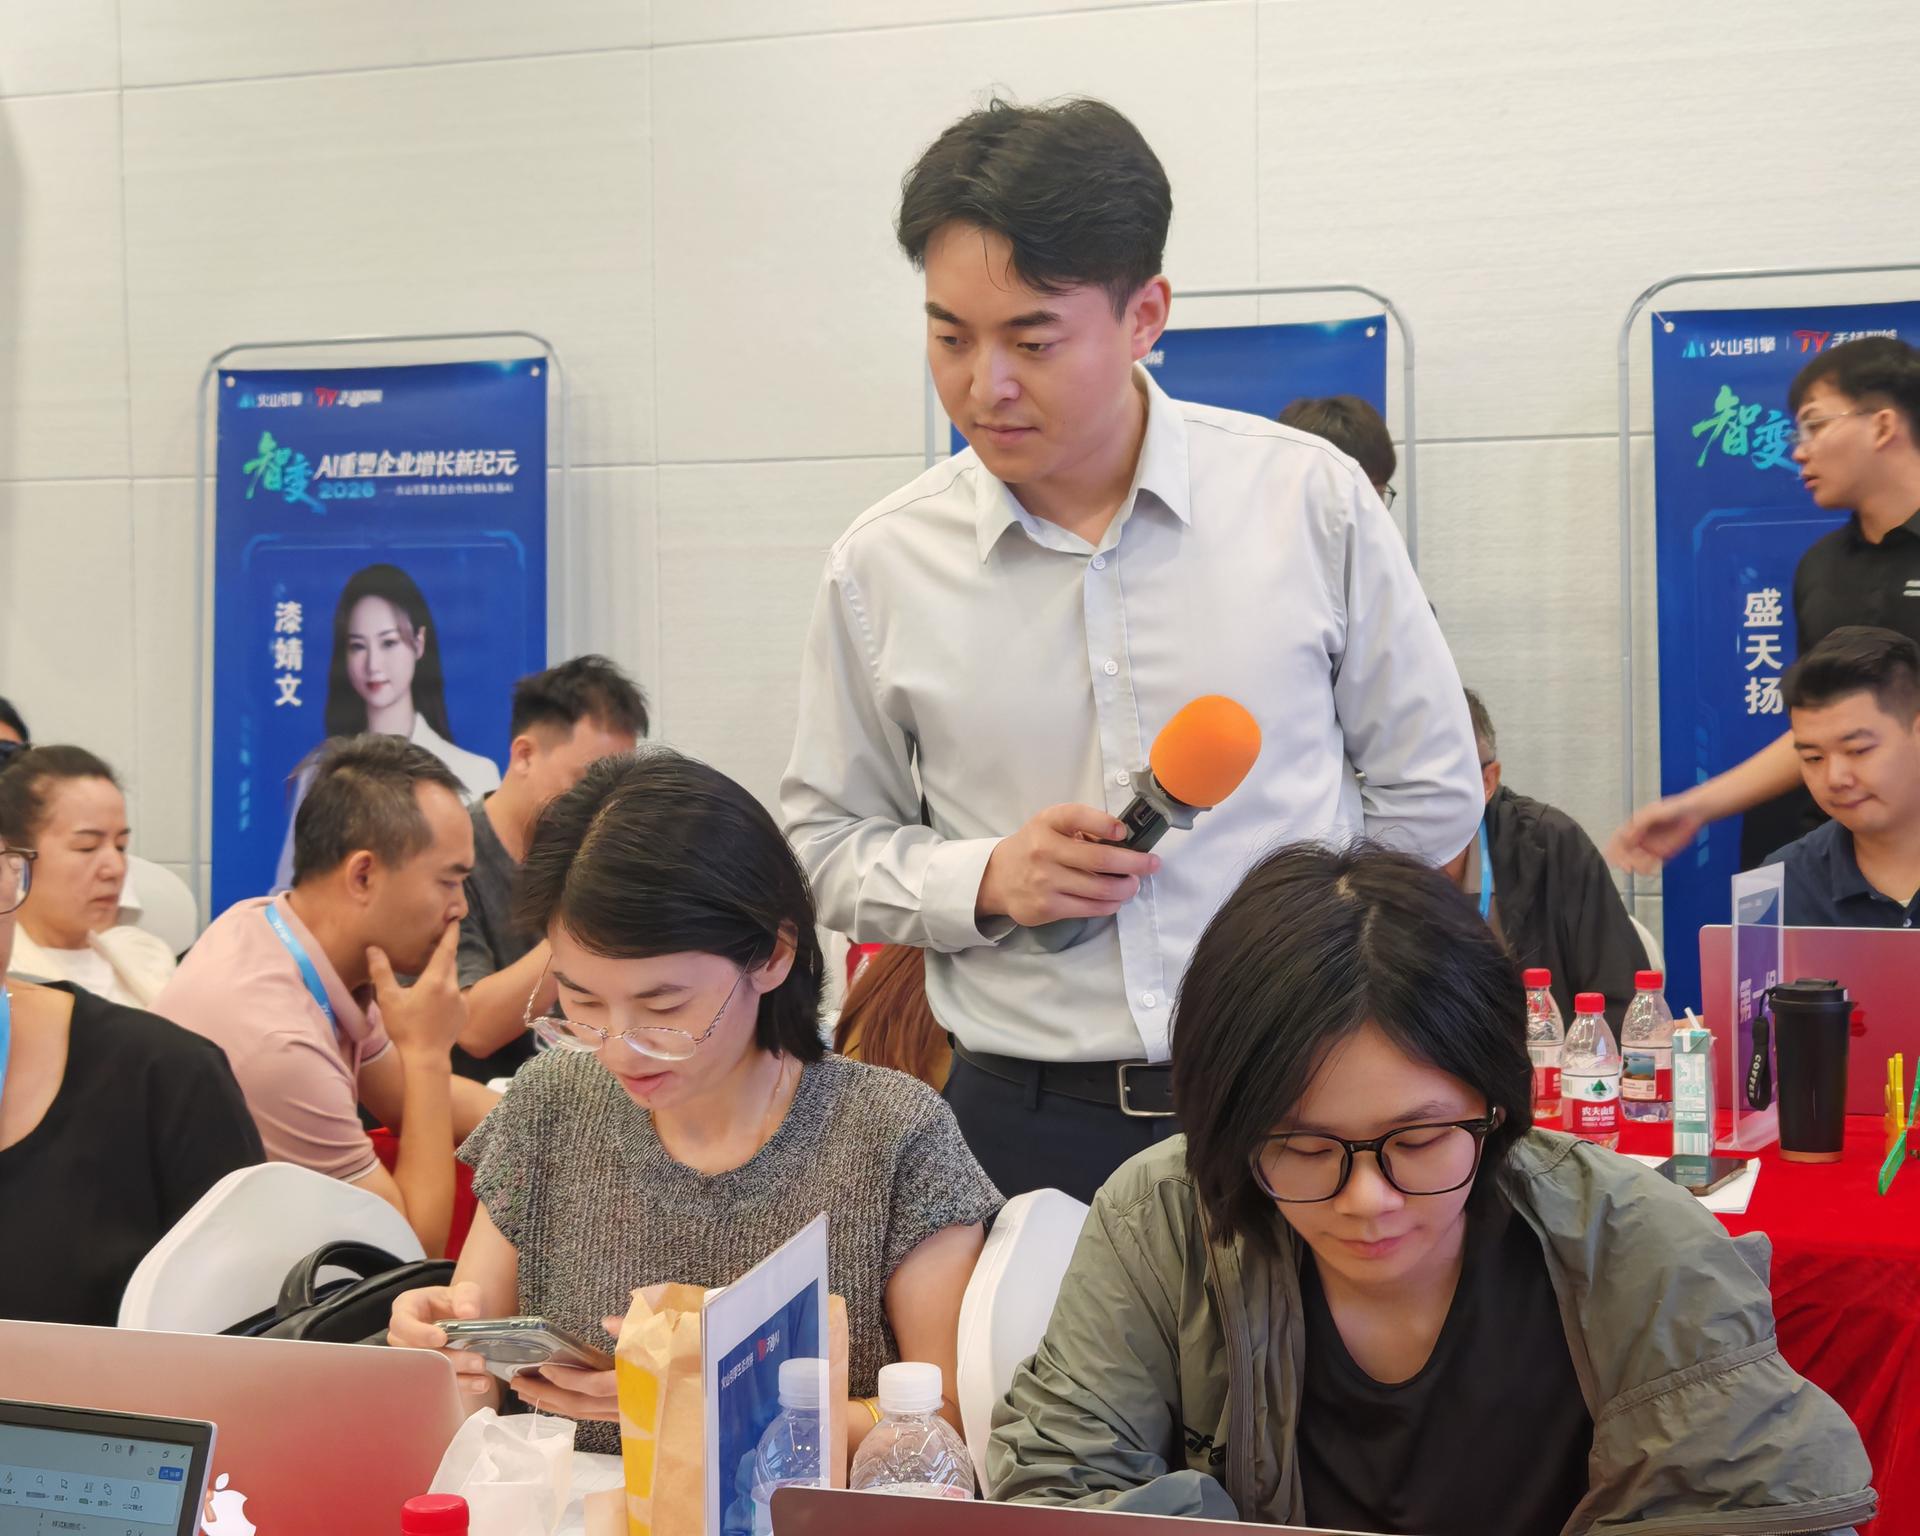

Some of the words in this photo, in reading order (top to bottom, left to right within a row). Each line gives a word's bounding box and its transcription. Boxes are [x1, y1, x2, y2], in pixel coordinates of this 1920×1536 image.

[1710, 336, 1776, 357] 火山引擎
[1692, 384, 1801, 472] 智变
[313, 450, 520, 481] AI重塑企业增长新纪元
[1743, 587, 1784, 715] 盛天扬
[1748, 1054, 1762, 1099] COFFEE
